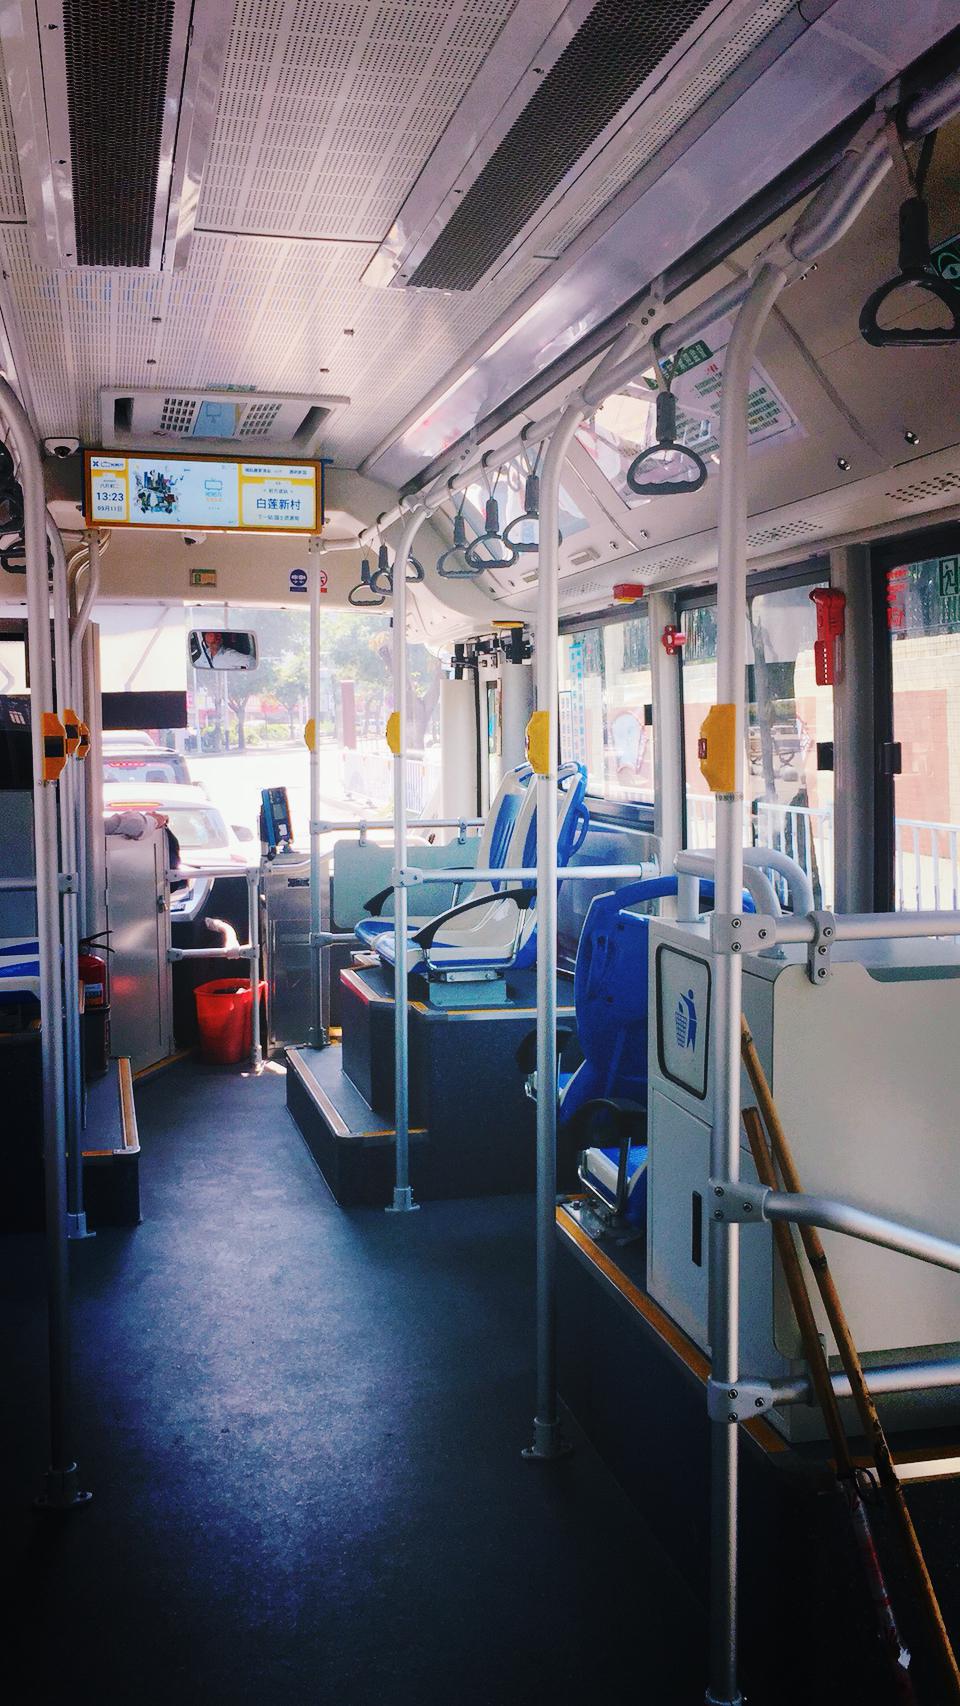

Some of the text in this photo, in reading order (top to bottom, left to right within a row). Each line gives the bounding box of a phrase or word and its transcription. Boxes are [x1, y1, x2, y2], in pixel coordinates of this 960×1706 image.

[96, 492, 124, 502] 13:23
[256, 498, 301, 511] 白莲新村
